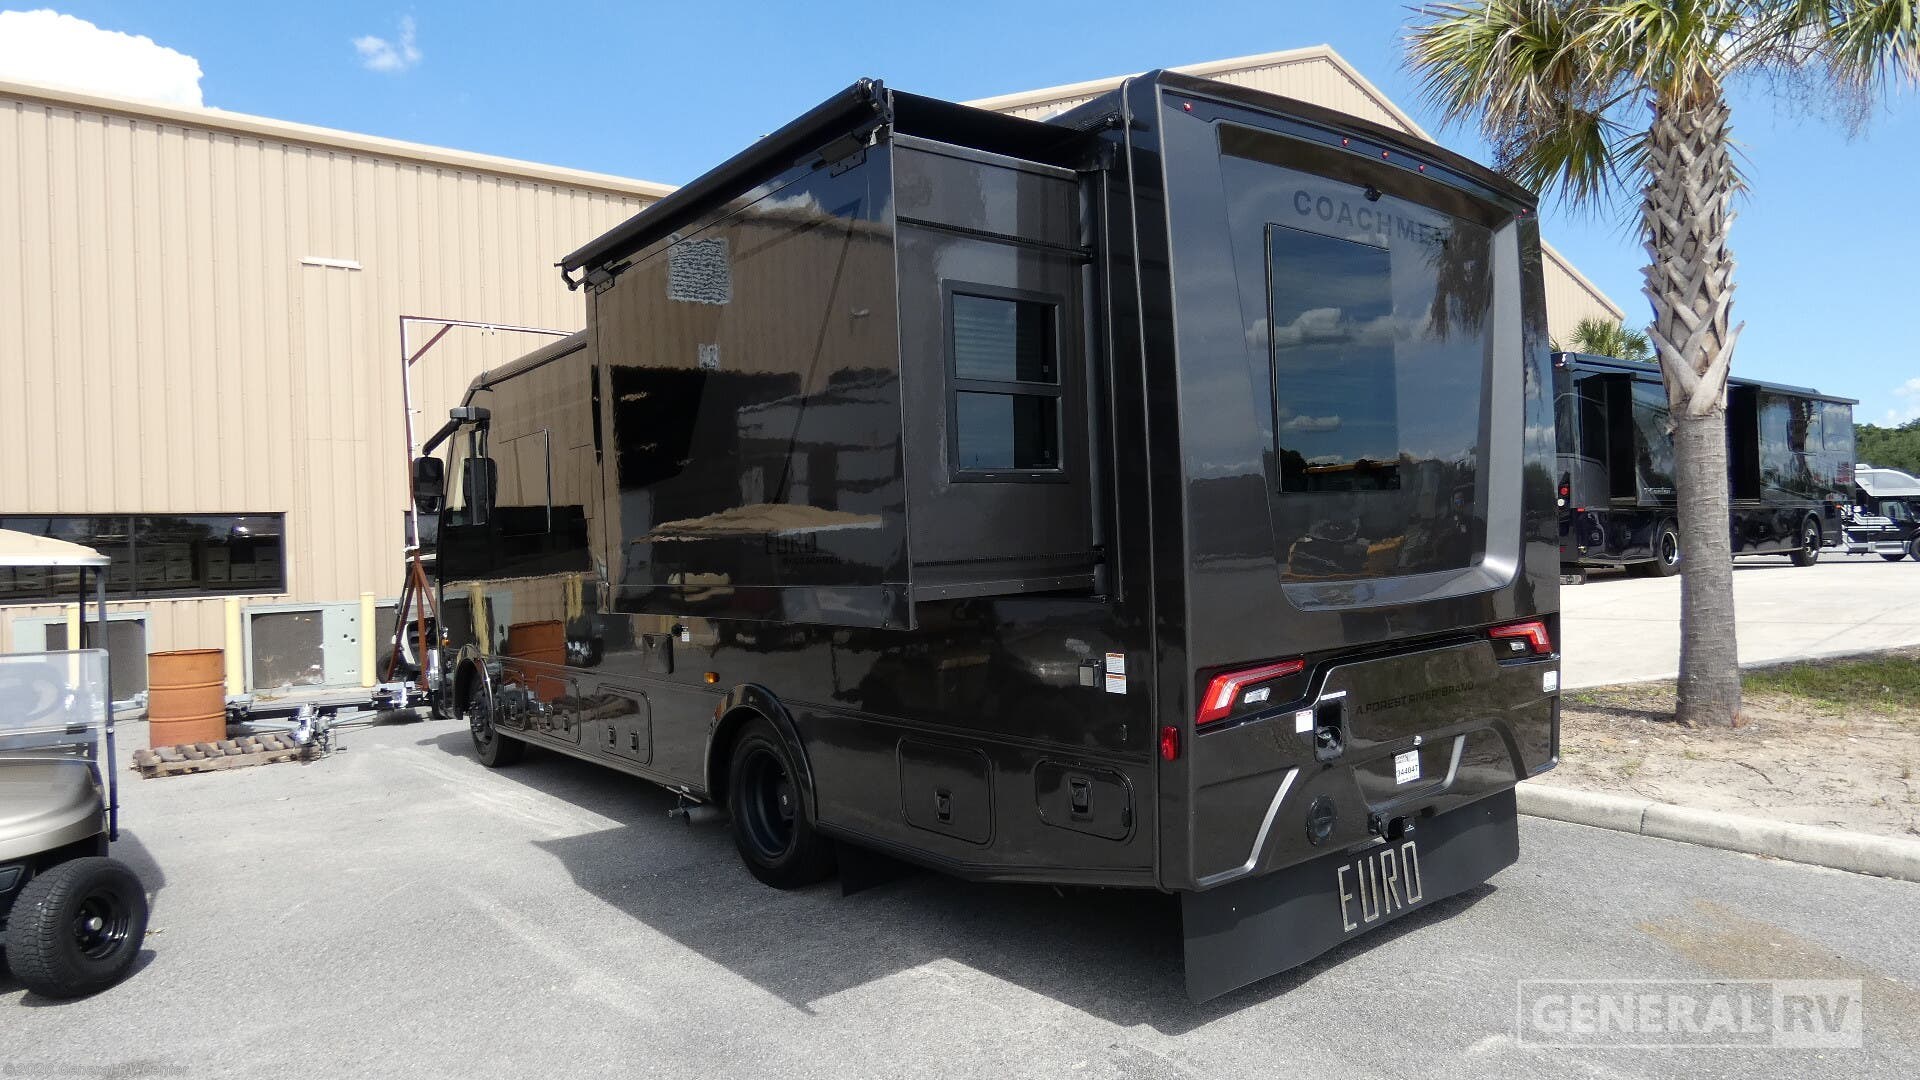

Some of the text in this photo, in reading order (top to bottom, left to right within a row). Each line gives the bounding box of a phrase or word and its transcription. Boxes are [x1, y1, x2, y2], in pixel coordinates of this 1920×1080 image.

[1366, 695, 1407, 712] FOREST
[1409, 690, 1438, 705] RIVER
[1441, 684, 1474, 698] BRAND
[1337, 841, 1422, 932] EURO
